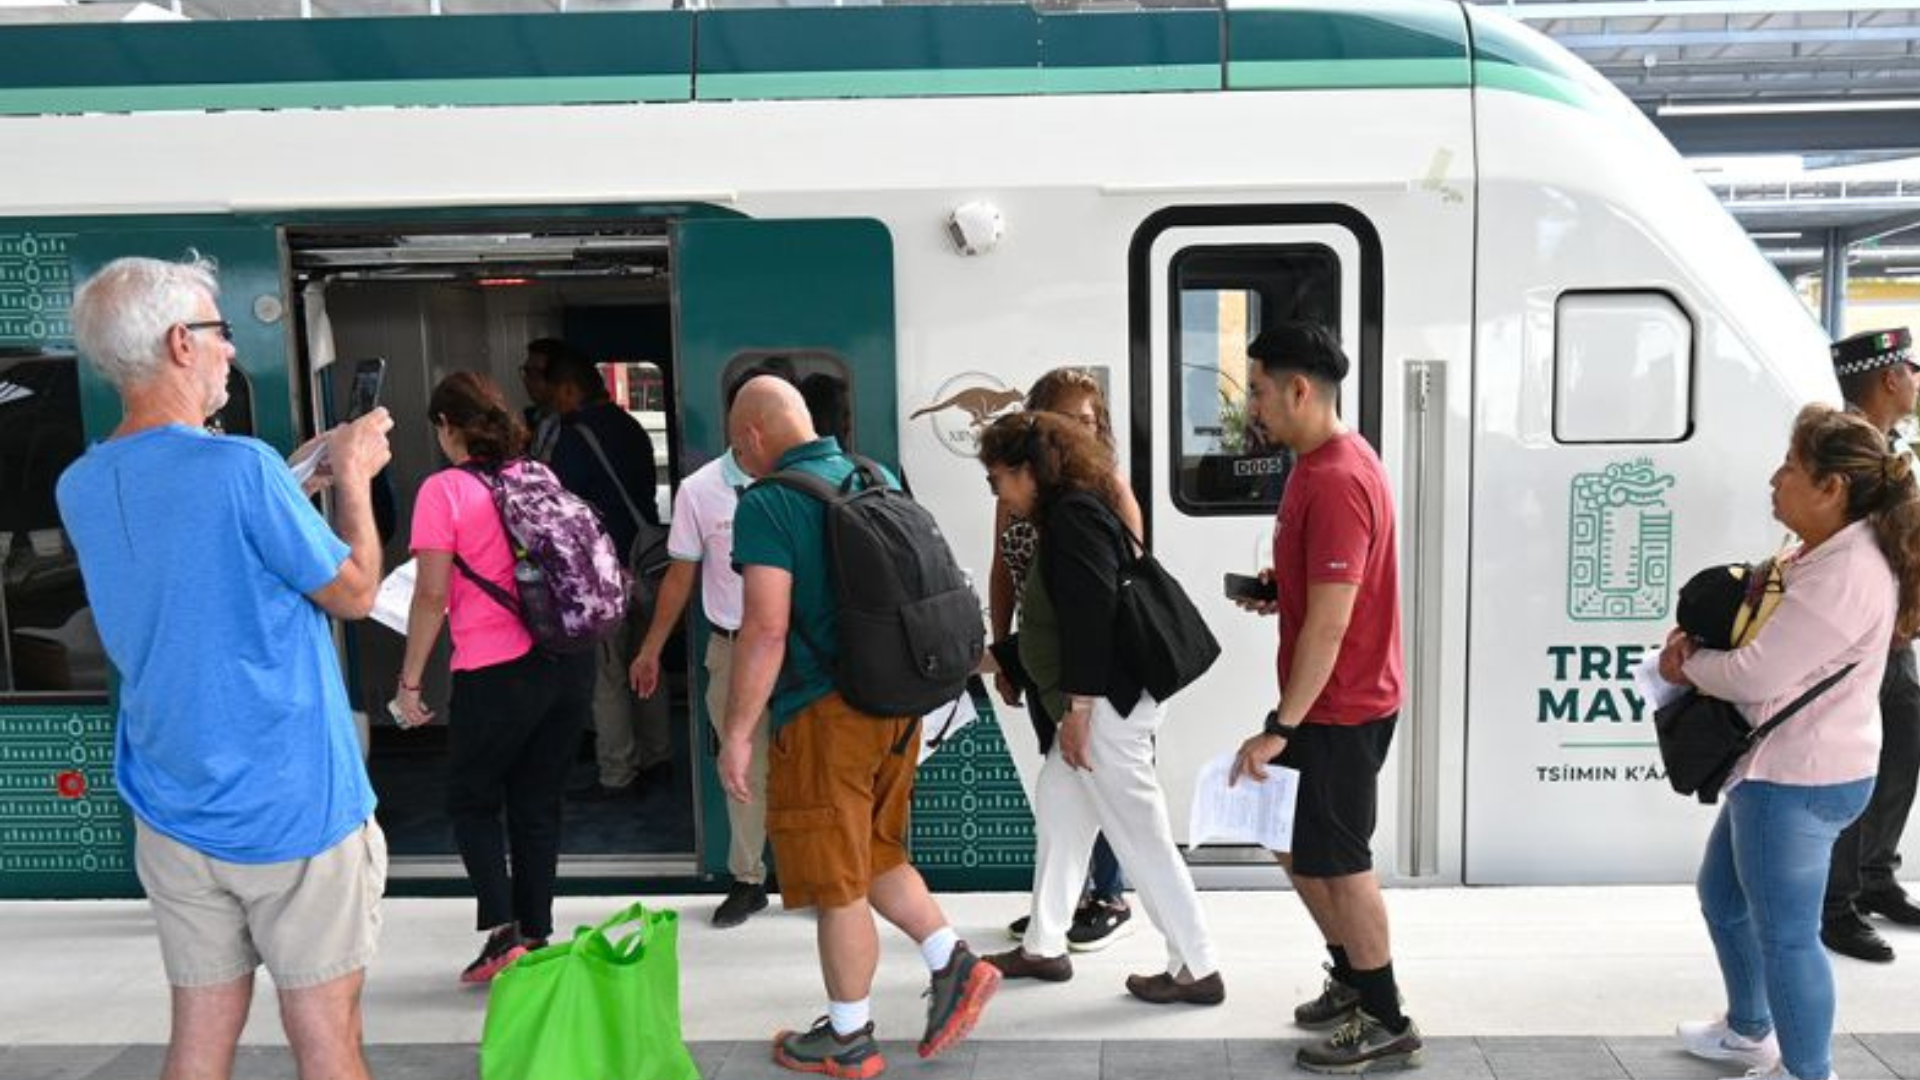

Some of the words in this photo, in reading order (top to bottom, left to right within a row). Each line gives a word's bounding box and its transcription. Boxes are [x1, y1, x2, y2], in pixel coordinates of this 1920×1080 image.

[1547, 646, 1661, 681] TRE
[1537, 688, 1646, 722] MAY
[1536, 764, 1617, 781] TSÍIMIN
